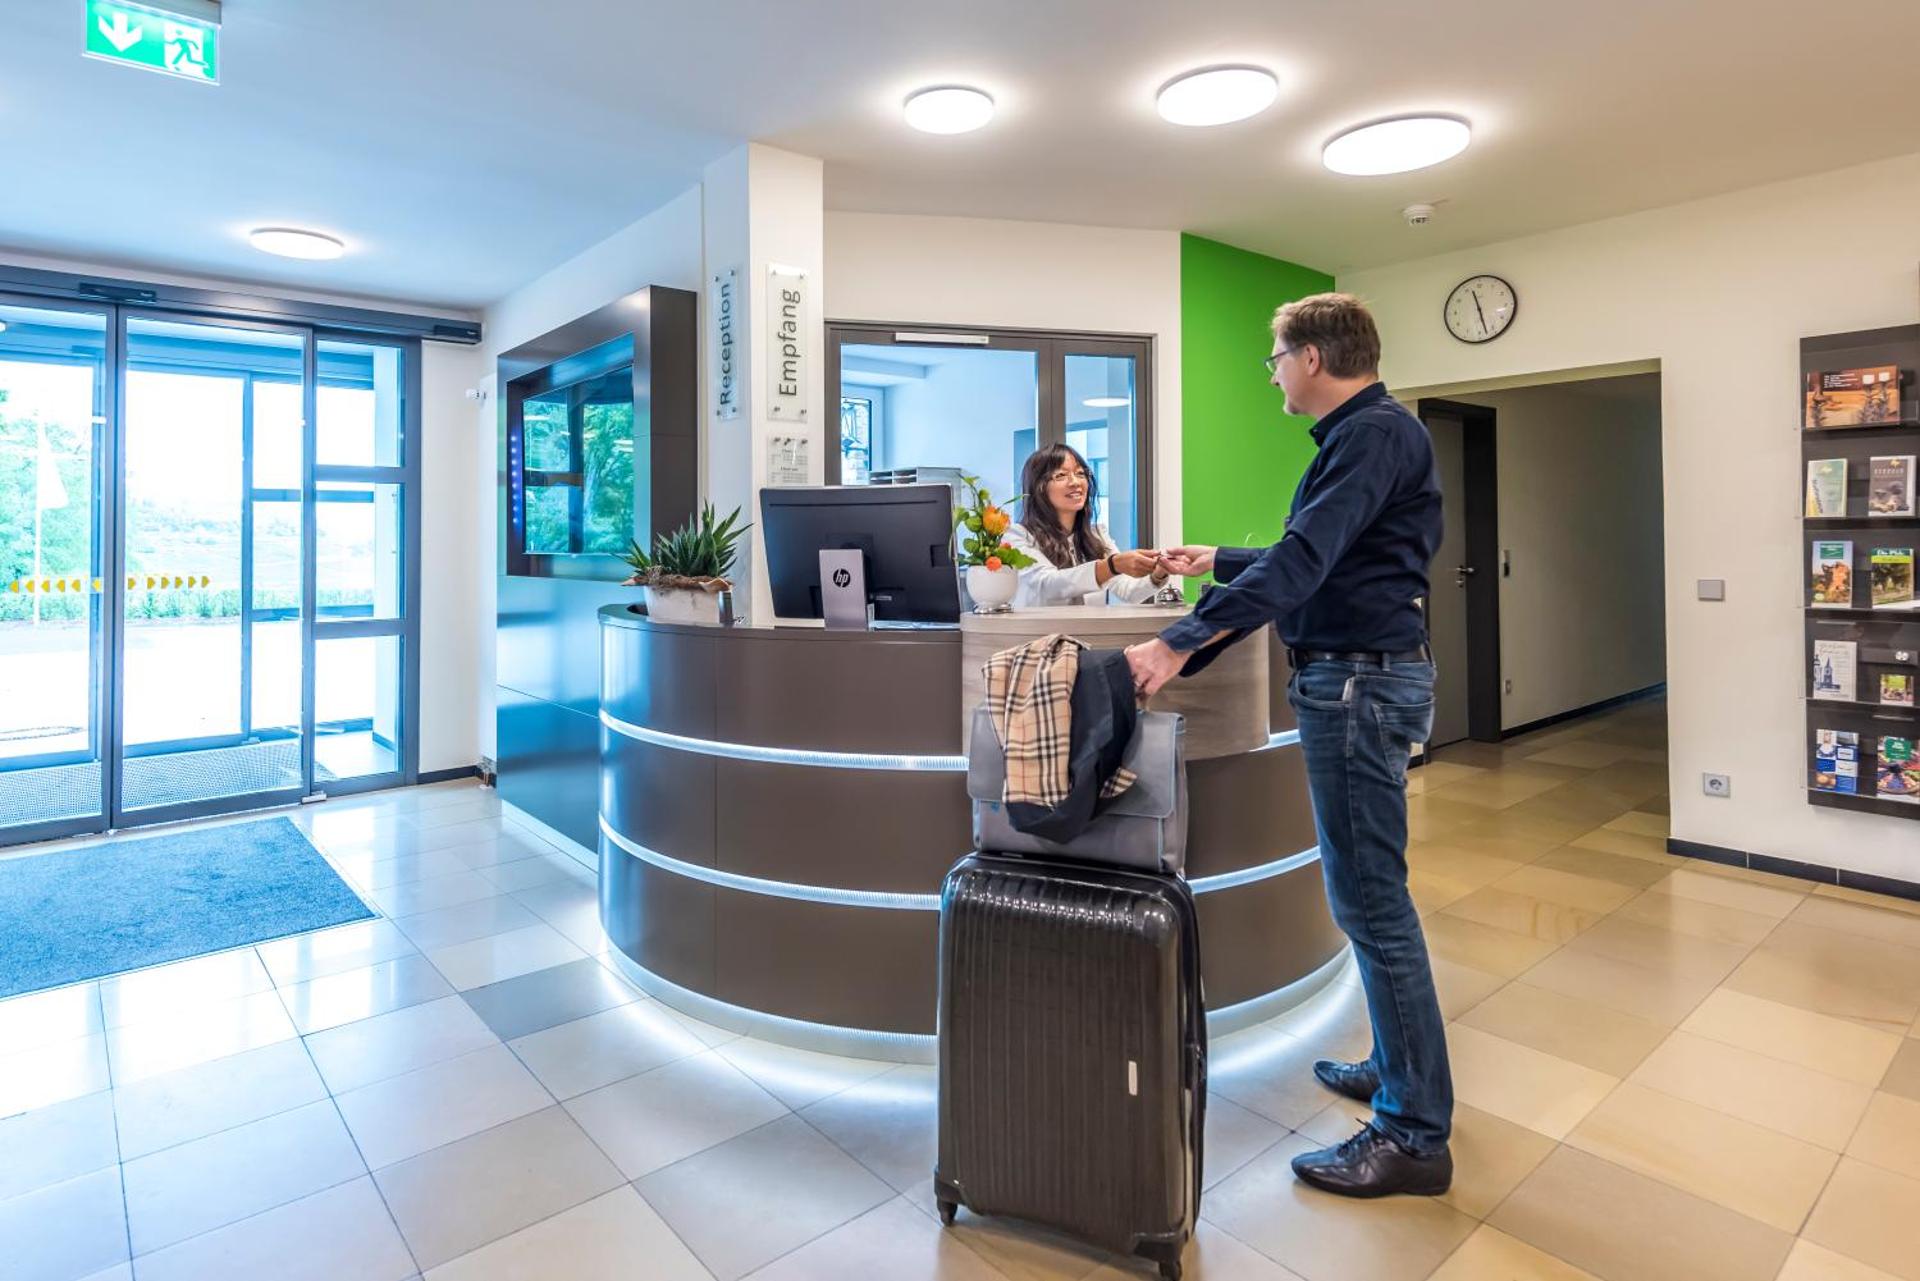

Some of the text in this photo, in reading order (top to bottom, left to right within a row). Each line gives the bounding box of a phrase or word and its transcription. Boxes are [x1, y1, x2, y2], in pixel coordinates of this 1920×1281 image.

[719, 283, 733, 405] Reception
[778, 289, 801, 396] Empfang
[833, 568, 850, 587] hp
